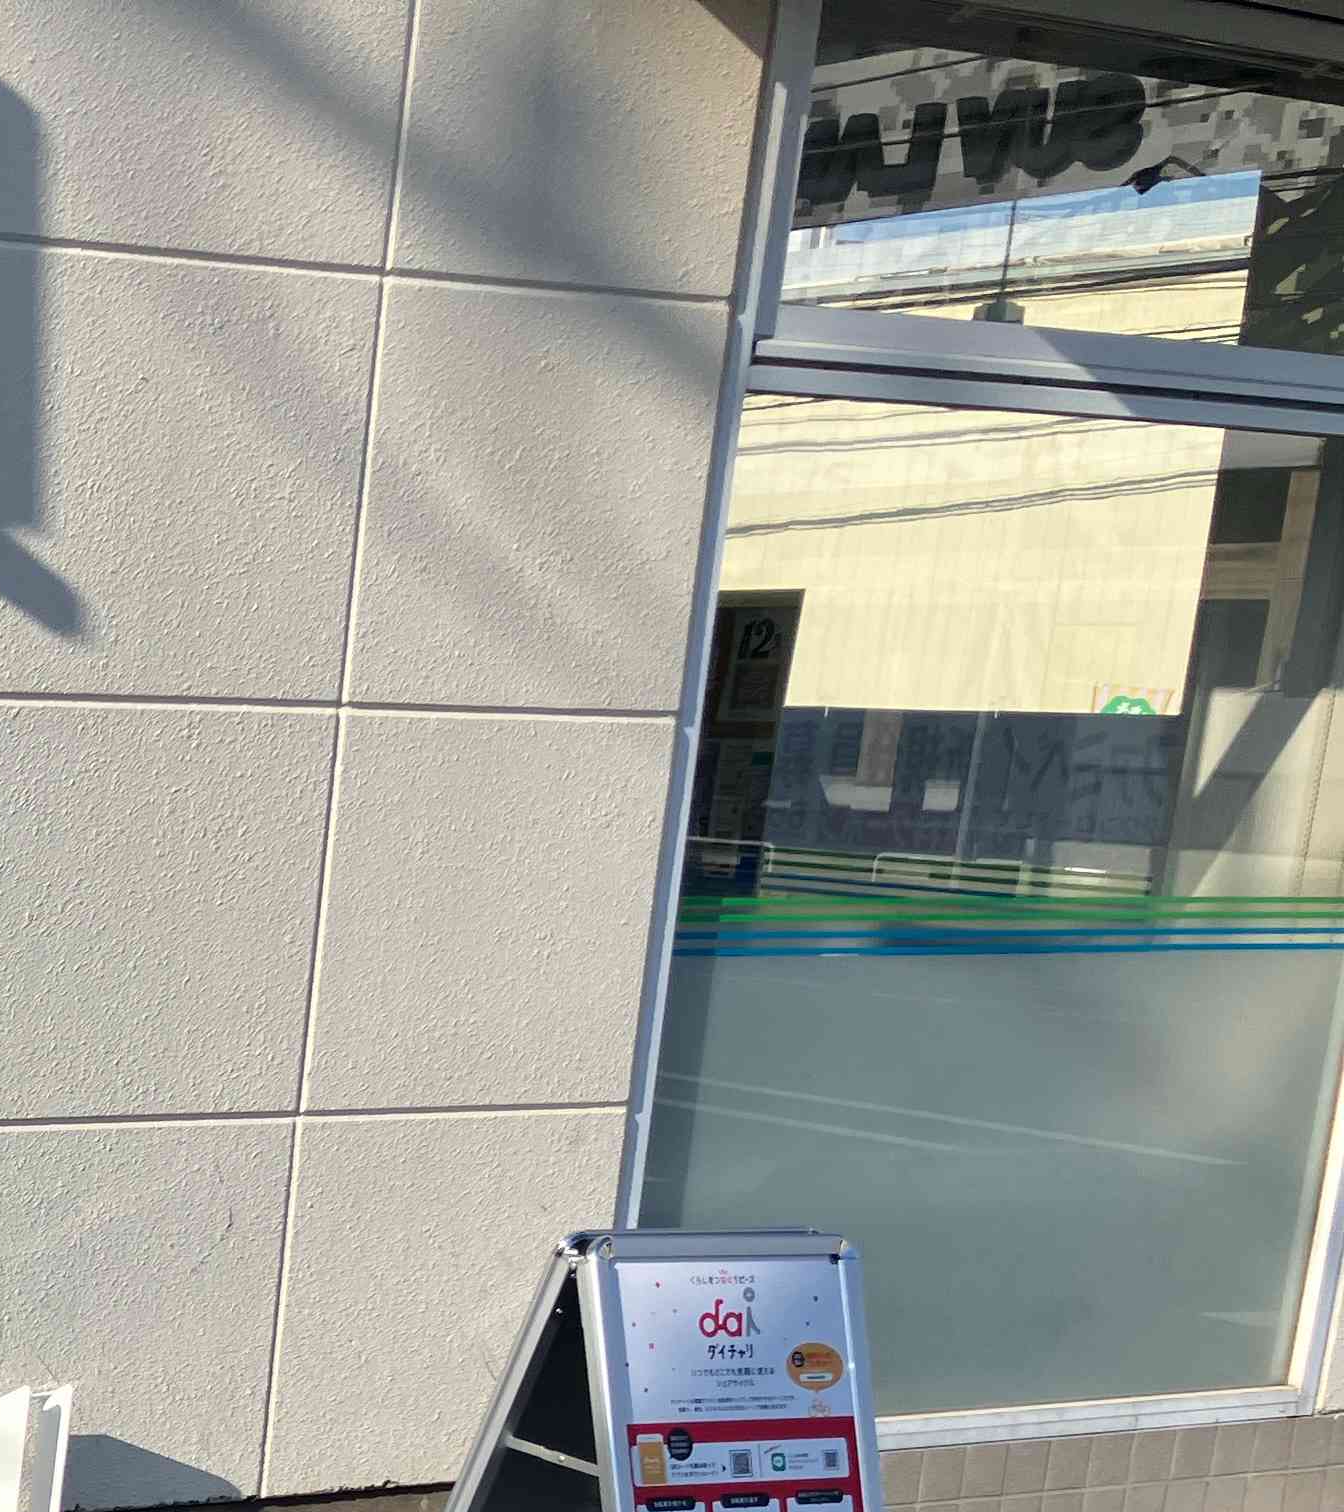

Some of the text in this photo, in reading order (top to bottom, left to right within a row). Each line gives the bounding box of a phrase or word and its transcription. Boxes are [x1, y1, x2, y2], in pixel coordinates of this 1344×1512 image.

[706, 1344, 753, 1360] ダイチャリ
